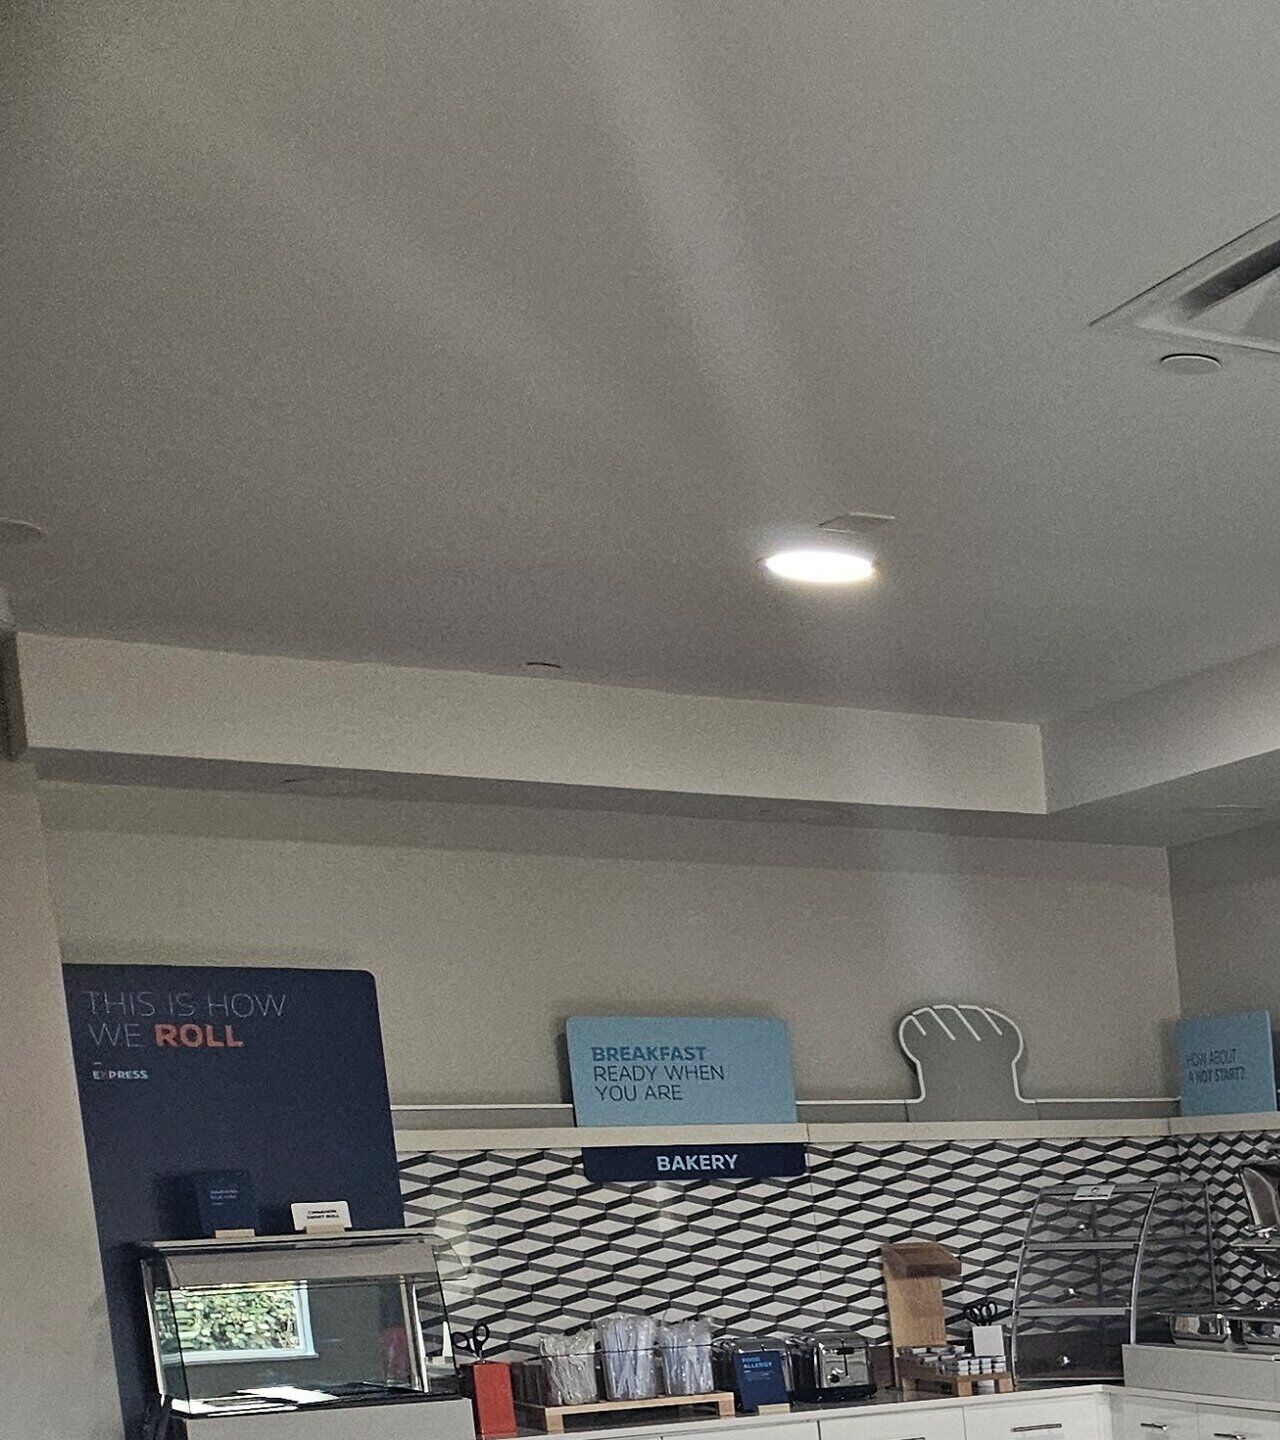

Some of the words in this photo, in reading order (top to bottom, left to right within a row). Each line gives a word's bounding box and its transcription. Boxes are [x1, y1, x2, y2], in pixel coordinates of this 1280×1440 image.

[86, 990, 156, 1017] THIS
[167, 991, 195, 1016] IS
[207, 992, 286, 1018] HOW
[87, 1022, 143, 1048] WE
[154, 1023, 244, 1048] ROLL
[591, 1046, 707, 1063] BREAKFAST
[594, 1065, 658, 1083] READY
[663, 1065, 725, 1082] WHEN
[595, 1084, 638, 1102] YOU
[644, 1084, 684, 1101] ARE
[656, 1154, 738, 1172] BAKERY
[743, 1361, 773, 1370] ALLERGY
